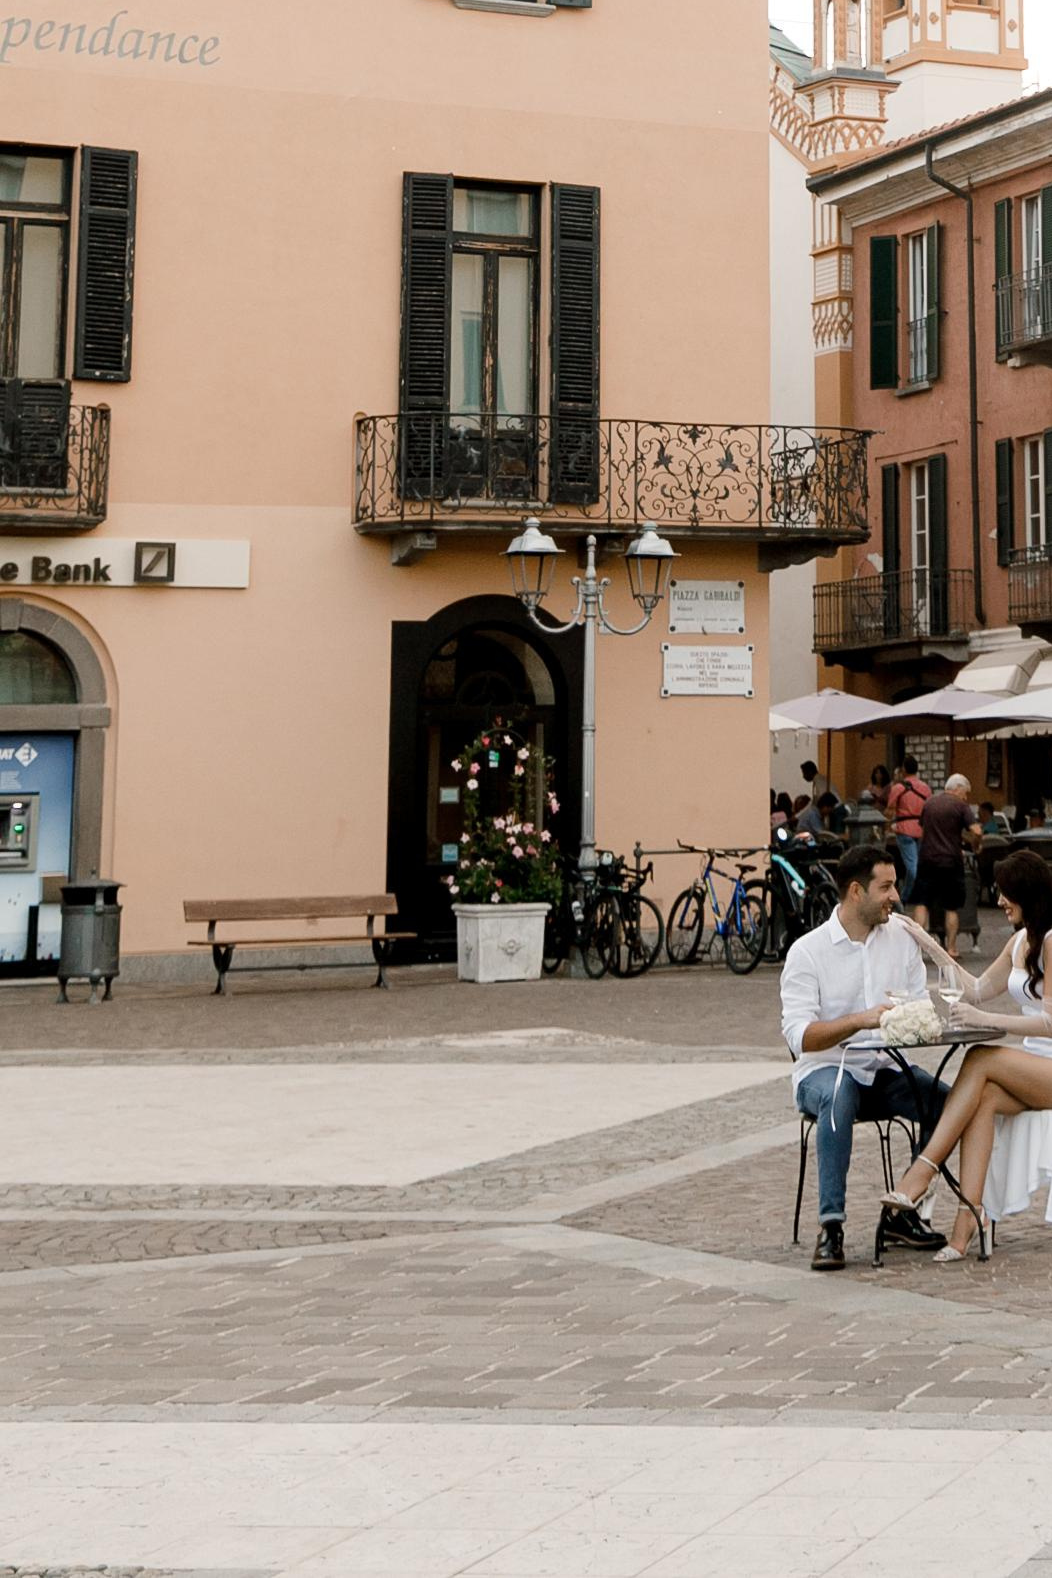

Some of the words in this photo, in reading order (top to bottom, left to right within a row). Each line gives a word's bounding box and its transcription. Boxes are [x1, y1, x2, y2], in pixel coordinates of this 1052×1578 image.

[0, 9, 222, 66] pendance
[31, 556, 112, 583] Bank
[672, 590, 700, 601] PIAZZA
[704, 590, 741, 602] GARIBALDI
